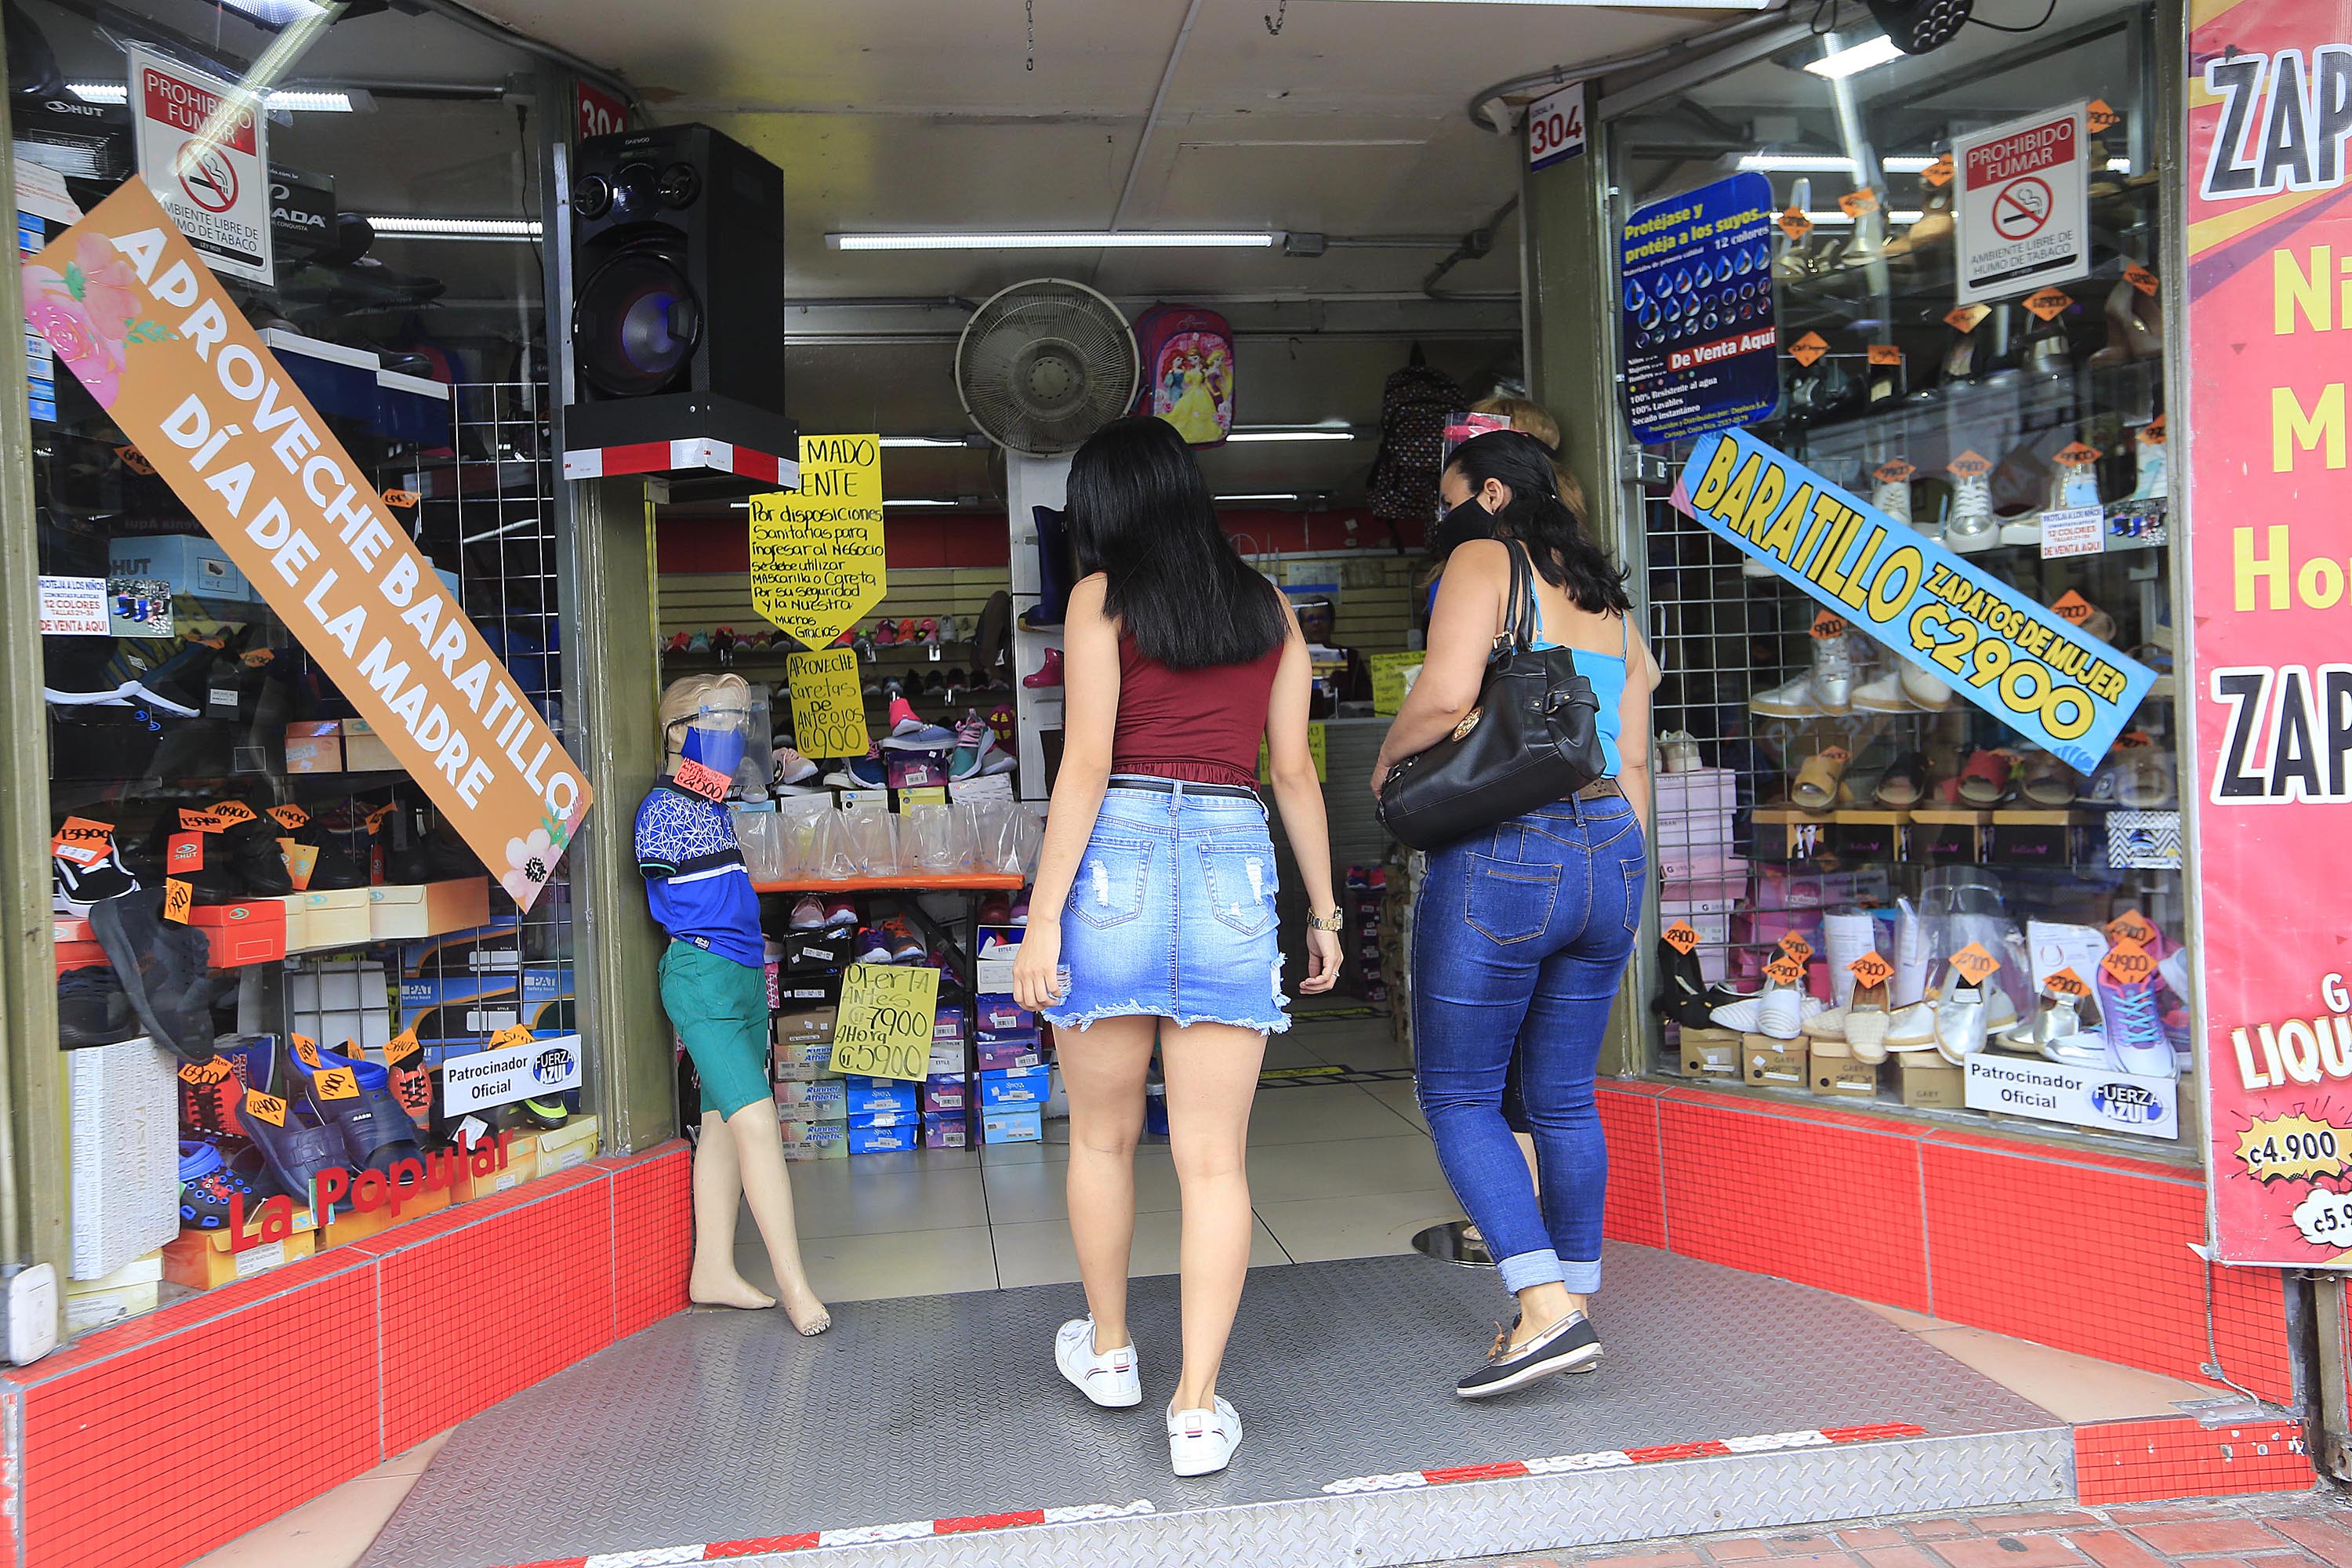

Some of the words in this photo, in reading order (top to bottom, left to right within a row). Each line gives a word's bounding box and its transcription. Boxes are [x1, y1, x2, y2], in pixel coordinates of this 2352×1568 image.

[148, 74, 252, 129] PROHIBO
[167, 103, 235, 143] FUMR
[1531, 105, 1582, 155] 304
[2204, 45, 2352, 199] ZAP
[1968, 122, 2072, 168] PROHIBIDO
[1985, 147, 2053, 181] FUMAR
[163, 201, 212, 226] MBIENTE
[214, 213, 245, 234] LIBRE
[245, 227, 259, 240] DE
[1624, 208, 1690, 241] Protéjase
[1693, 203, 1704, 219] y
[198, 226, 215, 240] DE
[216, 230, 257, 252] TABACO
[1625, 235, 1676, 263] protéja
[1679, 233, 1689, 245] a
[1690, 224, 1714, 241] los
[1715, 236, 1730, 250] 12
[1730, 226, 1769, 245] colores
[1971, 242, 2025, 265] AMBIENTE
[2026, 235, 2057, 255] LIBRE
[2057, 230, 2074, 242] DE
[1973, 258, 2008, 276] HUMO
[2011, 254, 2026, 268] DE
[2027, 243, 2071, 264] TABACO
[1671, 353, 1691, 369] De
[1693, 342, 1738, 363] Venta
[1628, 365, 1651, 375] Mujeres
[110, 227, 394, 572] APROVECHE
[1630, 392, 1651, 405] 100%
[1650, 383, 1690, 399] Resistente
[1690, 381, 1698, 390] al
[1698, 376, 1719, 389] agua
[1631, 405, 1653, 416] 100%
[1653, 397, 1685, 412] Lavables
[1632, 413, 1658, 426] Secado
[2271, 383, 2347, 474] M
[160, 394, 256, 519] DÍA
[751, 501, 775, 523] Por
[779, 505, 884, 530] disposiciones
[1692, 433, 1923, 624] BARATILLO
[245, 496, 321, 588] DE
[753, 524, 833, 540] Sanitarias
[834, 527, 868, 544] para
[813, 543, 827, 556] al
[798, 557, 846, 572] utilizar
[2233, 524, 2352, 613] Ho
[753, 586, 771, 598] Por
[813, 575, 822, 584] o
[824, 571, 877, 586] Careta
[57, 600, 100, 609] COLORES
[303, 568, 366, 659] LA
[774, 597, 787, 609] la
[40, 619, 53, 632] DE
[52, 619, 82, 632] VENTA
[85, 620, 107, 633] AQUI
[795, 625, 841, 639] Gracias
[1922, 562, 2027, 640] ZAPATOS
[2015, 616, 2053, 657] DE
[2043, 638, 2127, 706] MUJER
[379, 553, 579, 819] BARATILLO
[789, 677, 856, 700] Caretas
[358, 636, 495, 811] MADRE
[174, 850, 198, 861] SHUT
[1851, 959, 1886, 977] 2900
[2321, 972, 2351, 1014] G
[448, 1056, 528, 1083] Patrocinador
[534, 1050, 575, 1070] FUERZA
[539, 1064, 571, 1086] AZUL
[1971, 1063, 2084, 1091] Patrocinador
[471, 1080, 511, 1100] Oficial
[804, 1093, 841, 1102] Athletic
[806, 1085, 841, 1094] Runner
[2001, 1087, 2057, 1109] Oficial
[2096, 1083, 2162, 1109] FUERZA
[2101, 1101, 2150, 1125] AZUL
[805, 1132, 843, 1142] Athletic
[807, 1125, 842, 1134] Runner
[229, 1192, 293, 1254] La
[315, 1127, 514, 1228] Popular
